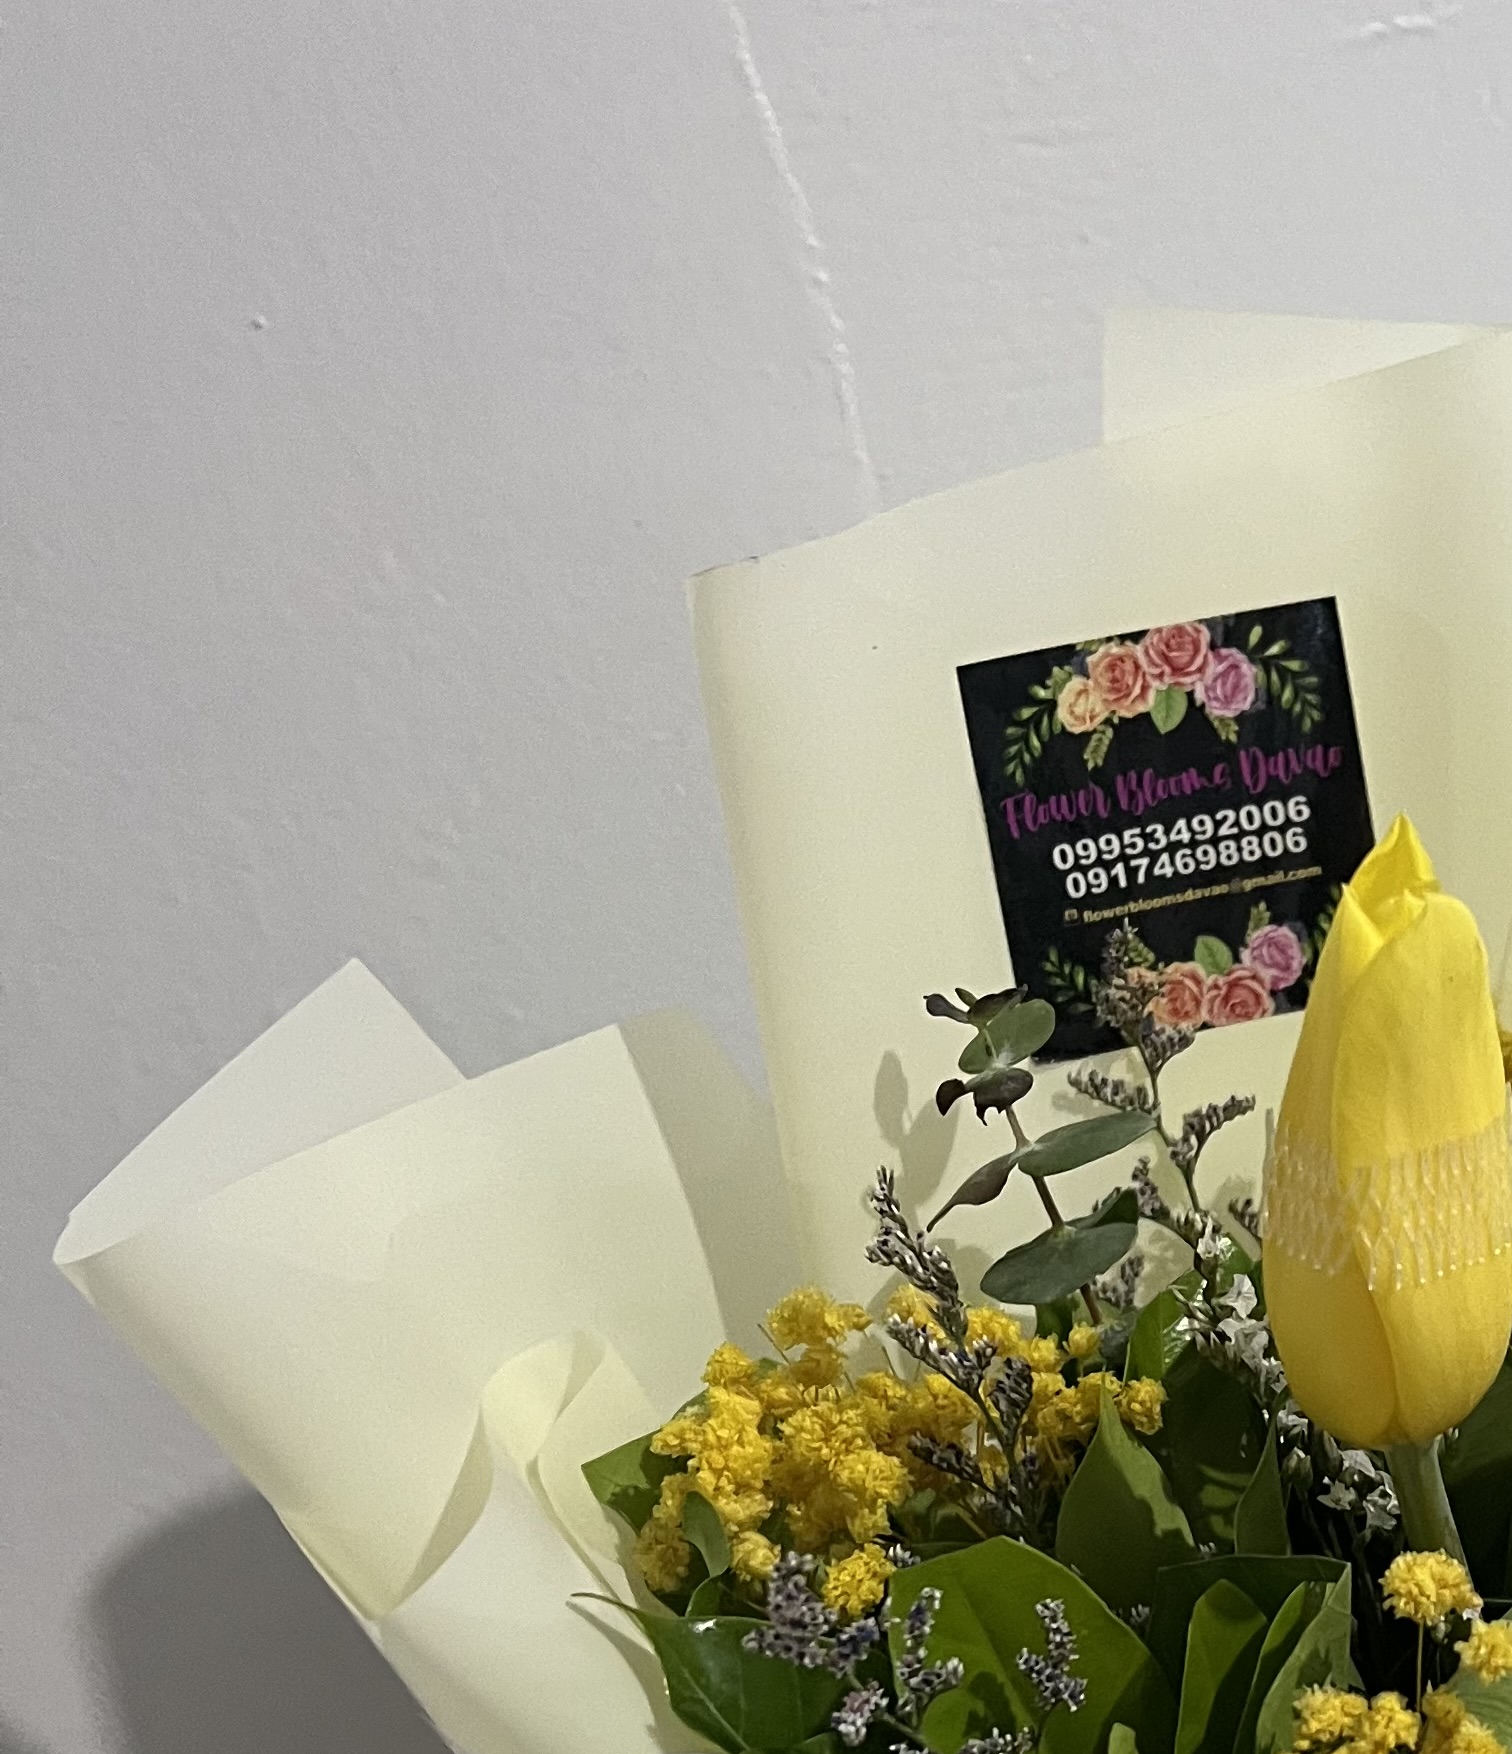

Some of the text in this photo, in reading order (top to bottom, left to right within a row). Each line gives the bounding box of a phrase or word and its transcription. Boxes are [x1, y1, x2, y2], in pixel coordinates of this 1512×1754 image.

[1000, 745, 1344, 839] Flower Blooms Davao
[1052, 795, 1311, 871] 09953492006
[1065, 827, 1308, 899] 09174698806
